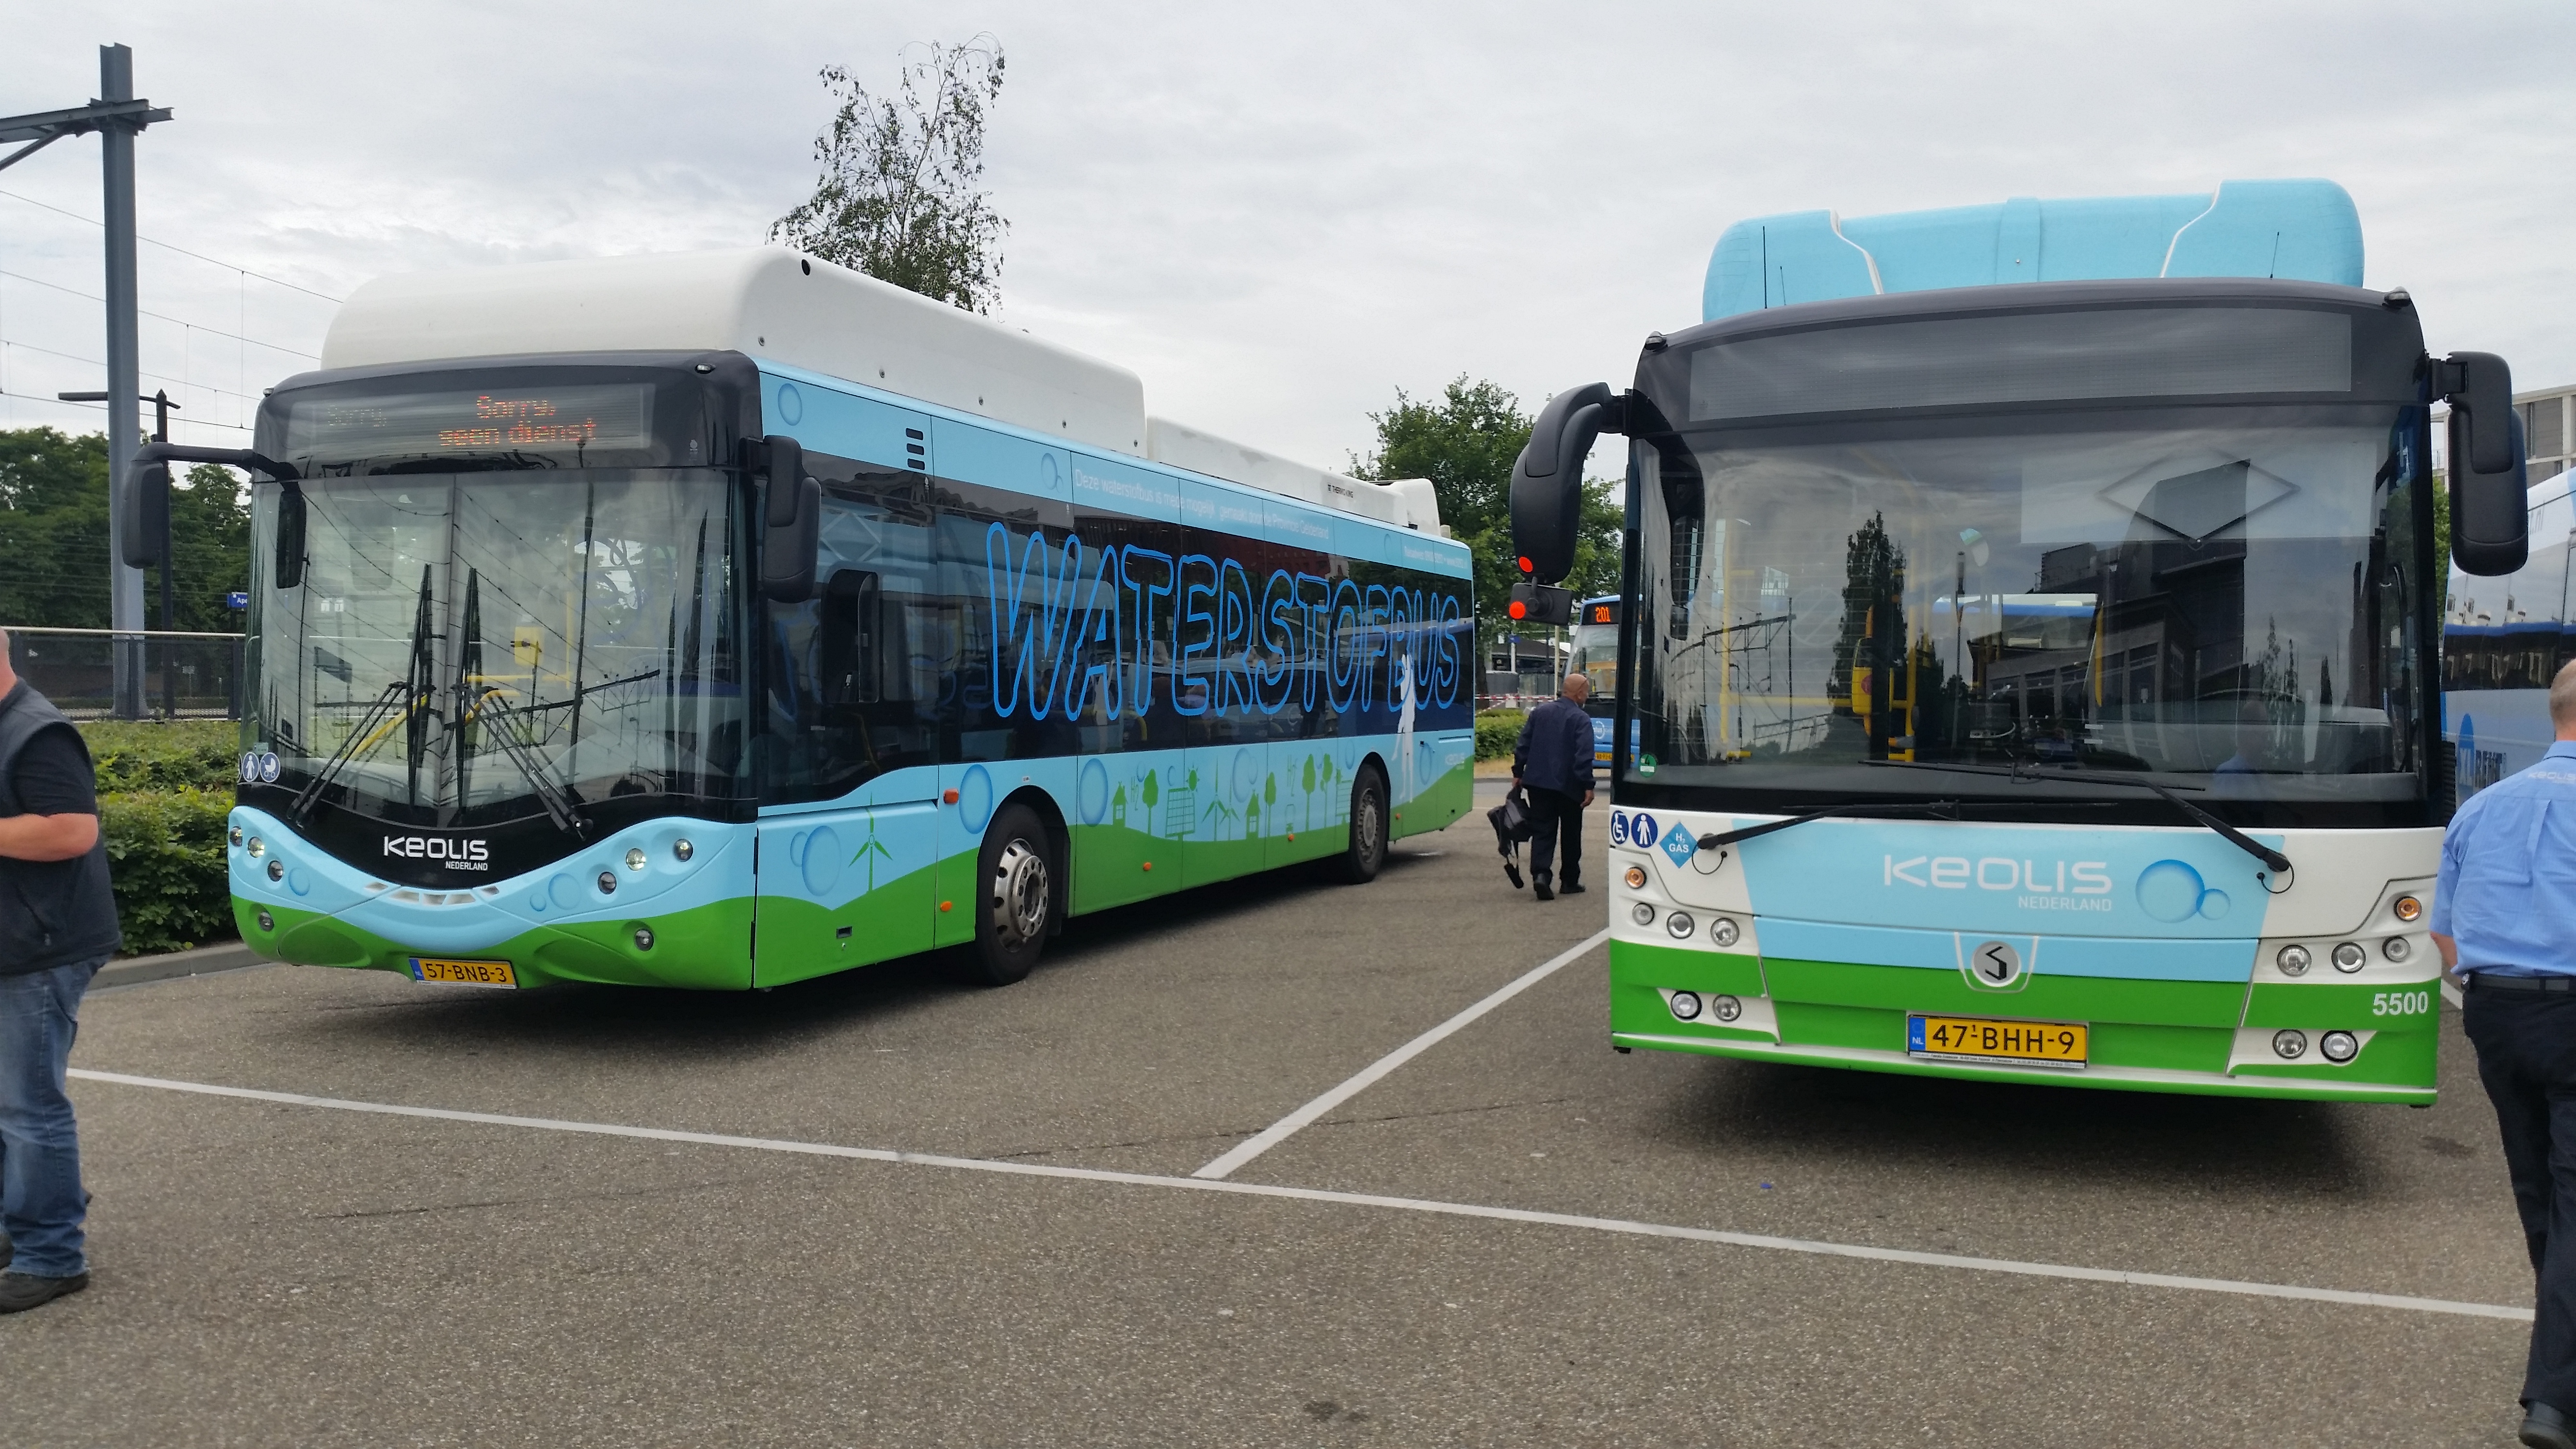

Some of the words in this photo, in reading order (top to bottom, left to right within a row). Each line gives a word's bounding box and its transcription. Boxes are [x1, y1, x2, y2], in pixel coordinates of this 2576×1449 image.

[477, 396, 555, 419] Sorry,
[1075, 468, 1099, 491] Deze
[986, 521, 1460, 722] WATERSTOFBUS
[1595, 606, 1610, 623] 201
[1669, 843, 1689, 853] GAS
[445, 861, 488, 871] NEDERLAND
[2018, 896, 2112, 912] NEDERLAND
[426, 963, 507, 982] 57-BNB-3
[2372, 991, 2429, 1015] 5500
[1912, 1037, 1924, 1045] NL
